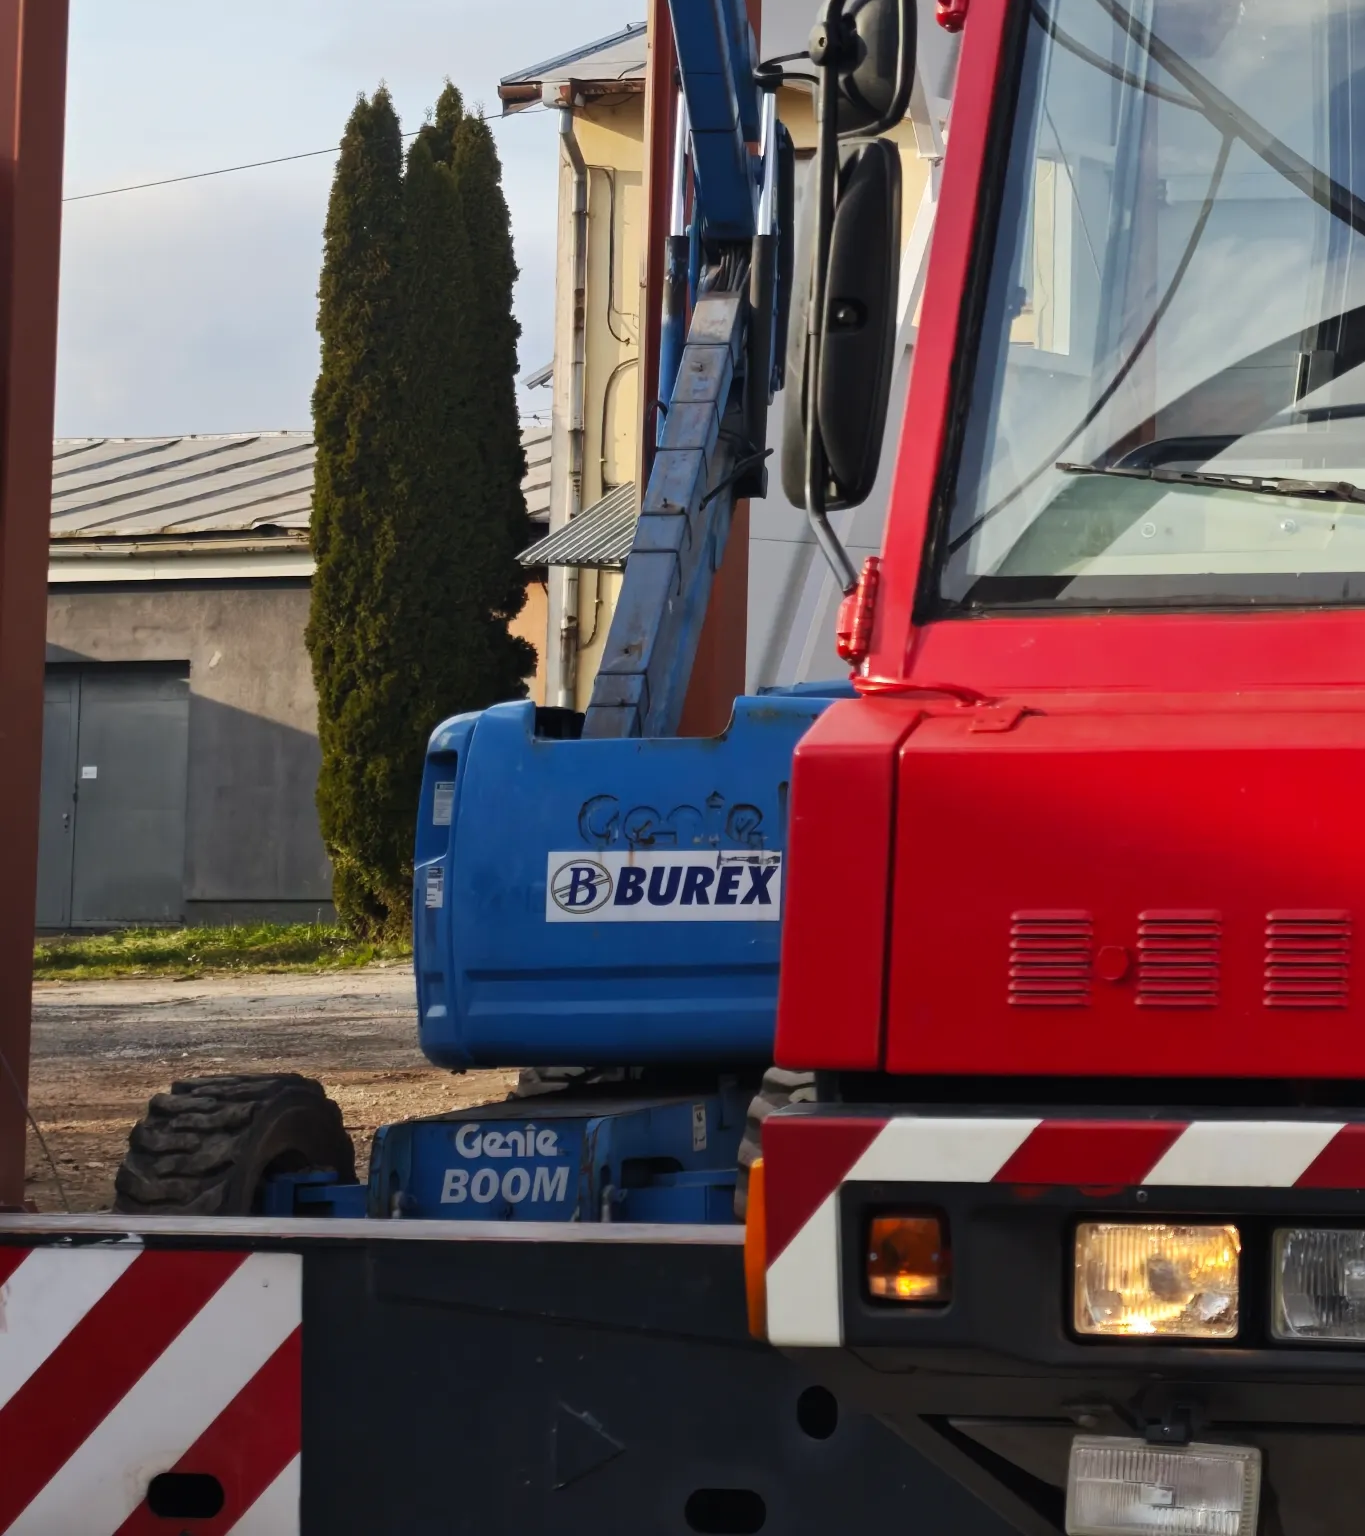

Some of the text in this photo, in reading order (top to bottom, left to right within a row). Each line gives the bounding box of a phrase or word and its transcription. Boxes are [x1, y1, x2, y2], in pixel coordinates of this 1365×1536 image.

[613, 866, 779, 906] BUREX
[455, 1123, 558, 1159] Genie
[440, 1166, 570, 1204] BOOM
